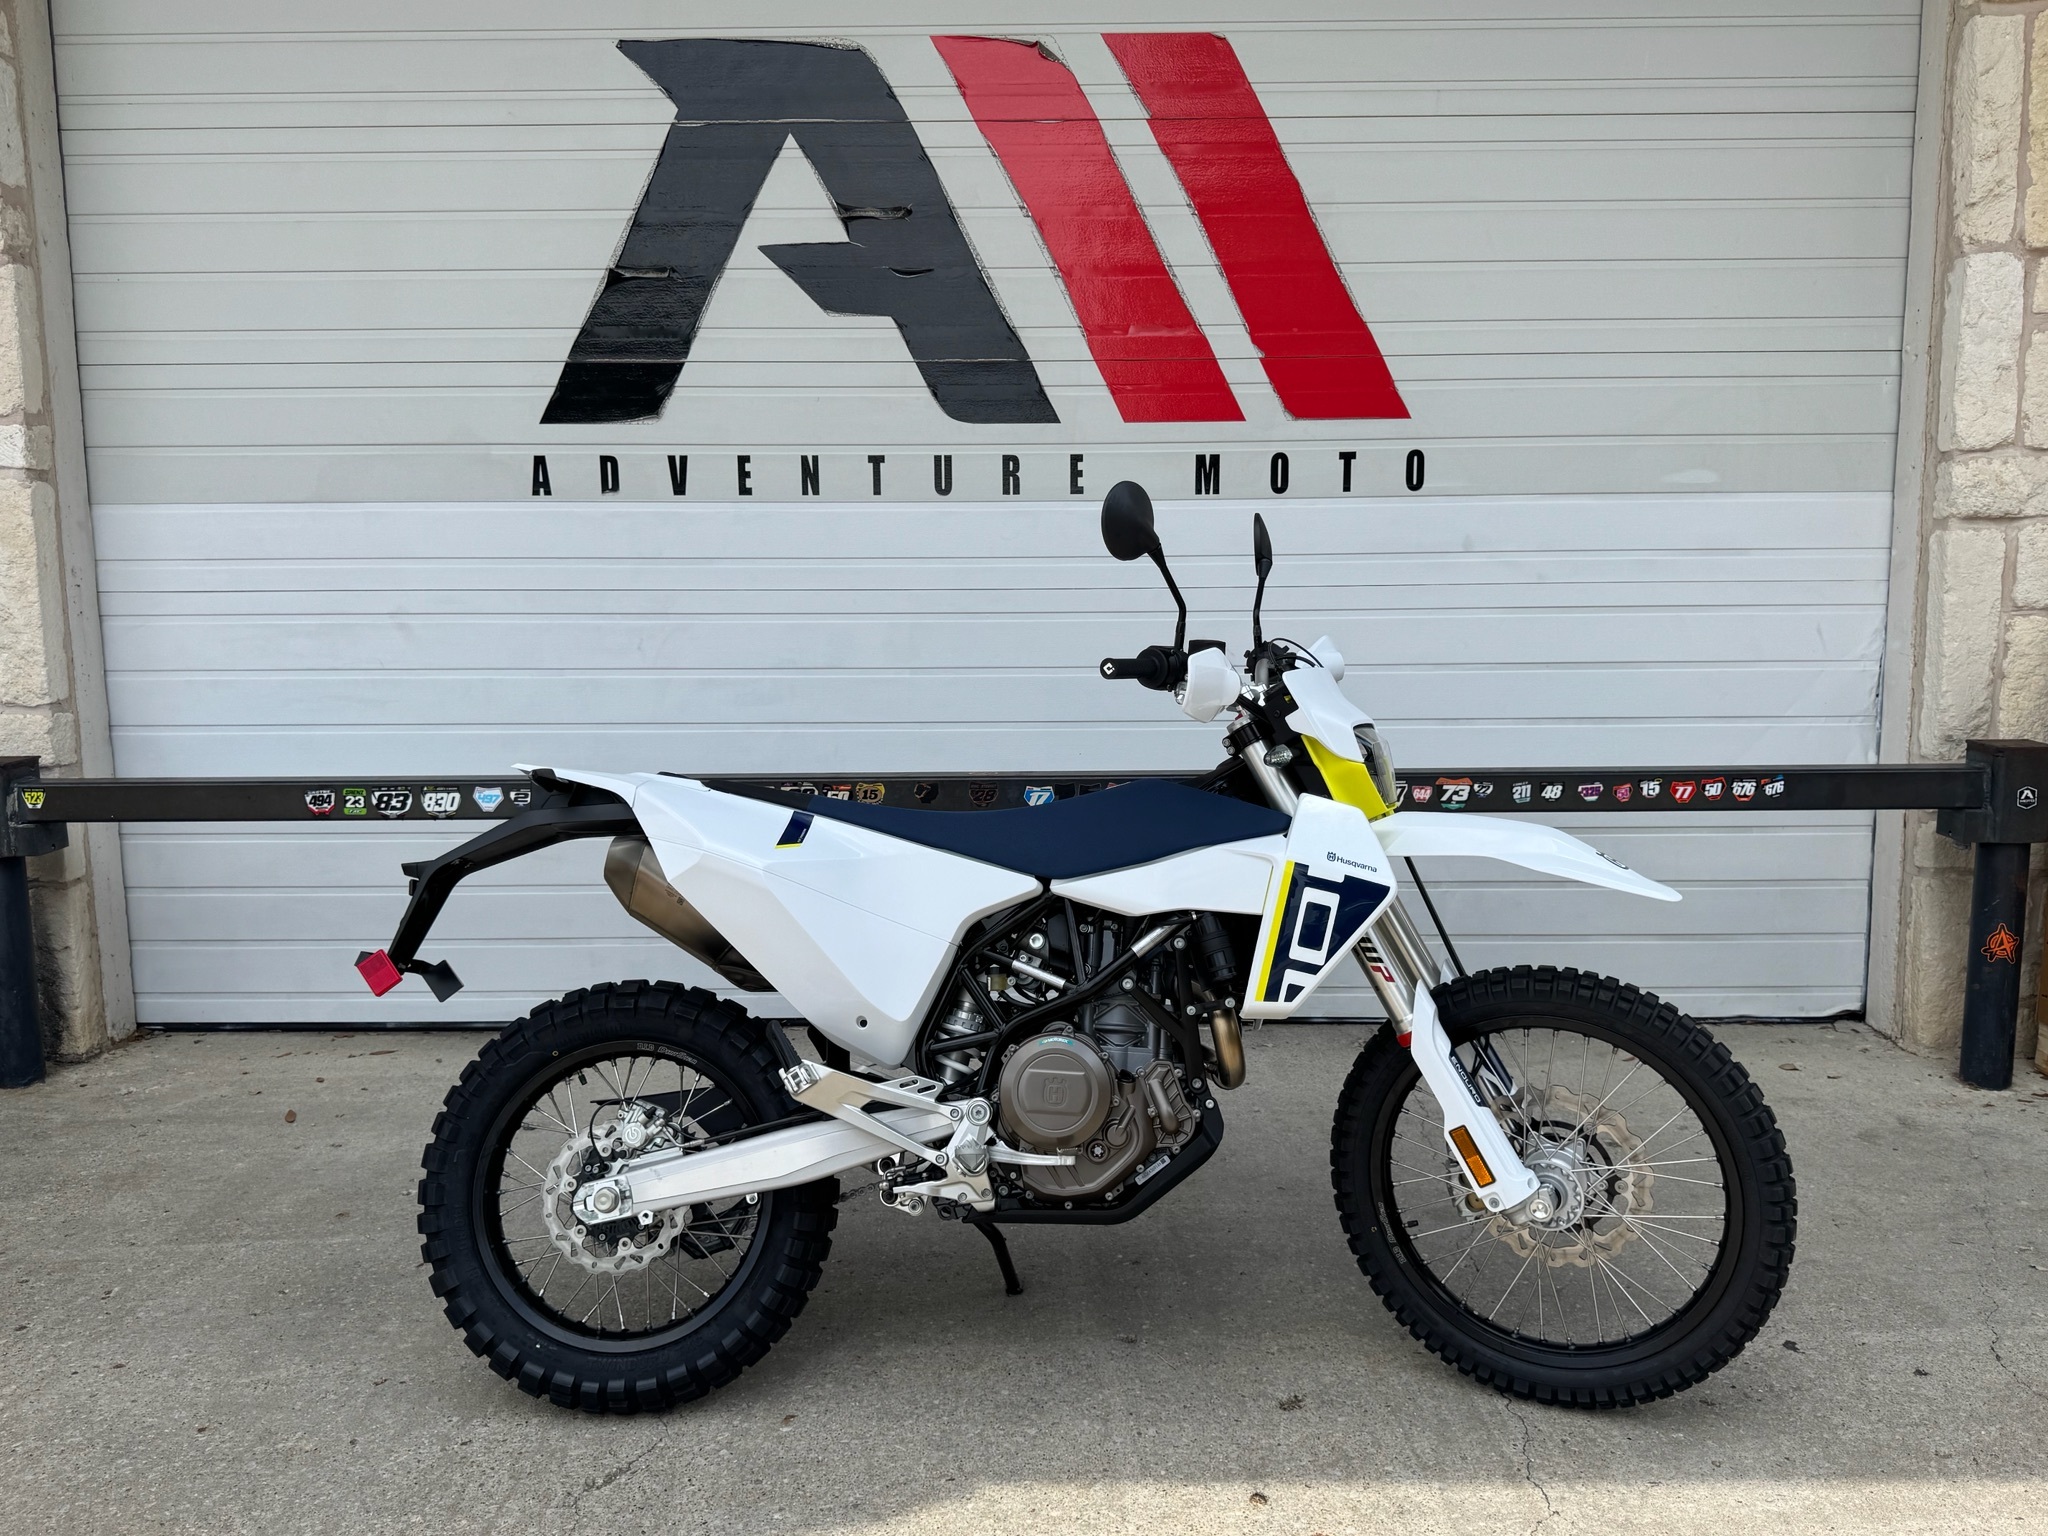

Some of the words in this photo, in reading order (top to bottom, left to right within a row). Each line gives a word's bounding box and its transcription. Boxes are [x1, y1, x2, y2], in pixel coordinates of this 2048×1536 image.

[531, 454, 1085, 496] ADVENTURE
[1195, 449, 1425, 495] MOTO
[861, 789, 879, 800] 15
[1440, 784, 1471, 802] 73
[1512, 784, 1532, 799] 211
[1540, 785, 1563, 799] 48
[1675, 786, 1693, 799] 77
[1704, 783, 1722, 797] 50
[24, 791, 44, 804] 523
[309, 794, 332, 807] 494
[345, 795, 365, 808] 23
[375, 793, 411, 811] 83
[423, 792, 461, 812] 830
[477, 793, 501, 804] 497
[1028, 791, 1051, 807] 17
[1336, 855, 1378, 873] Husqvarna
[1450, 1055, 1482, 1104] ENDURO
